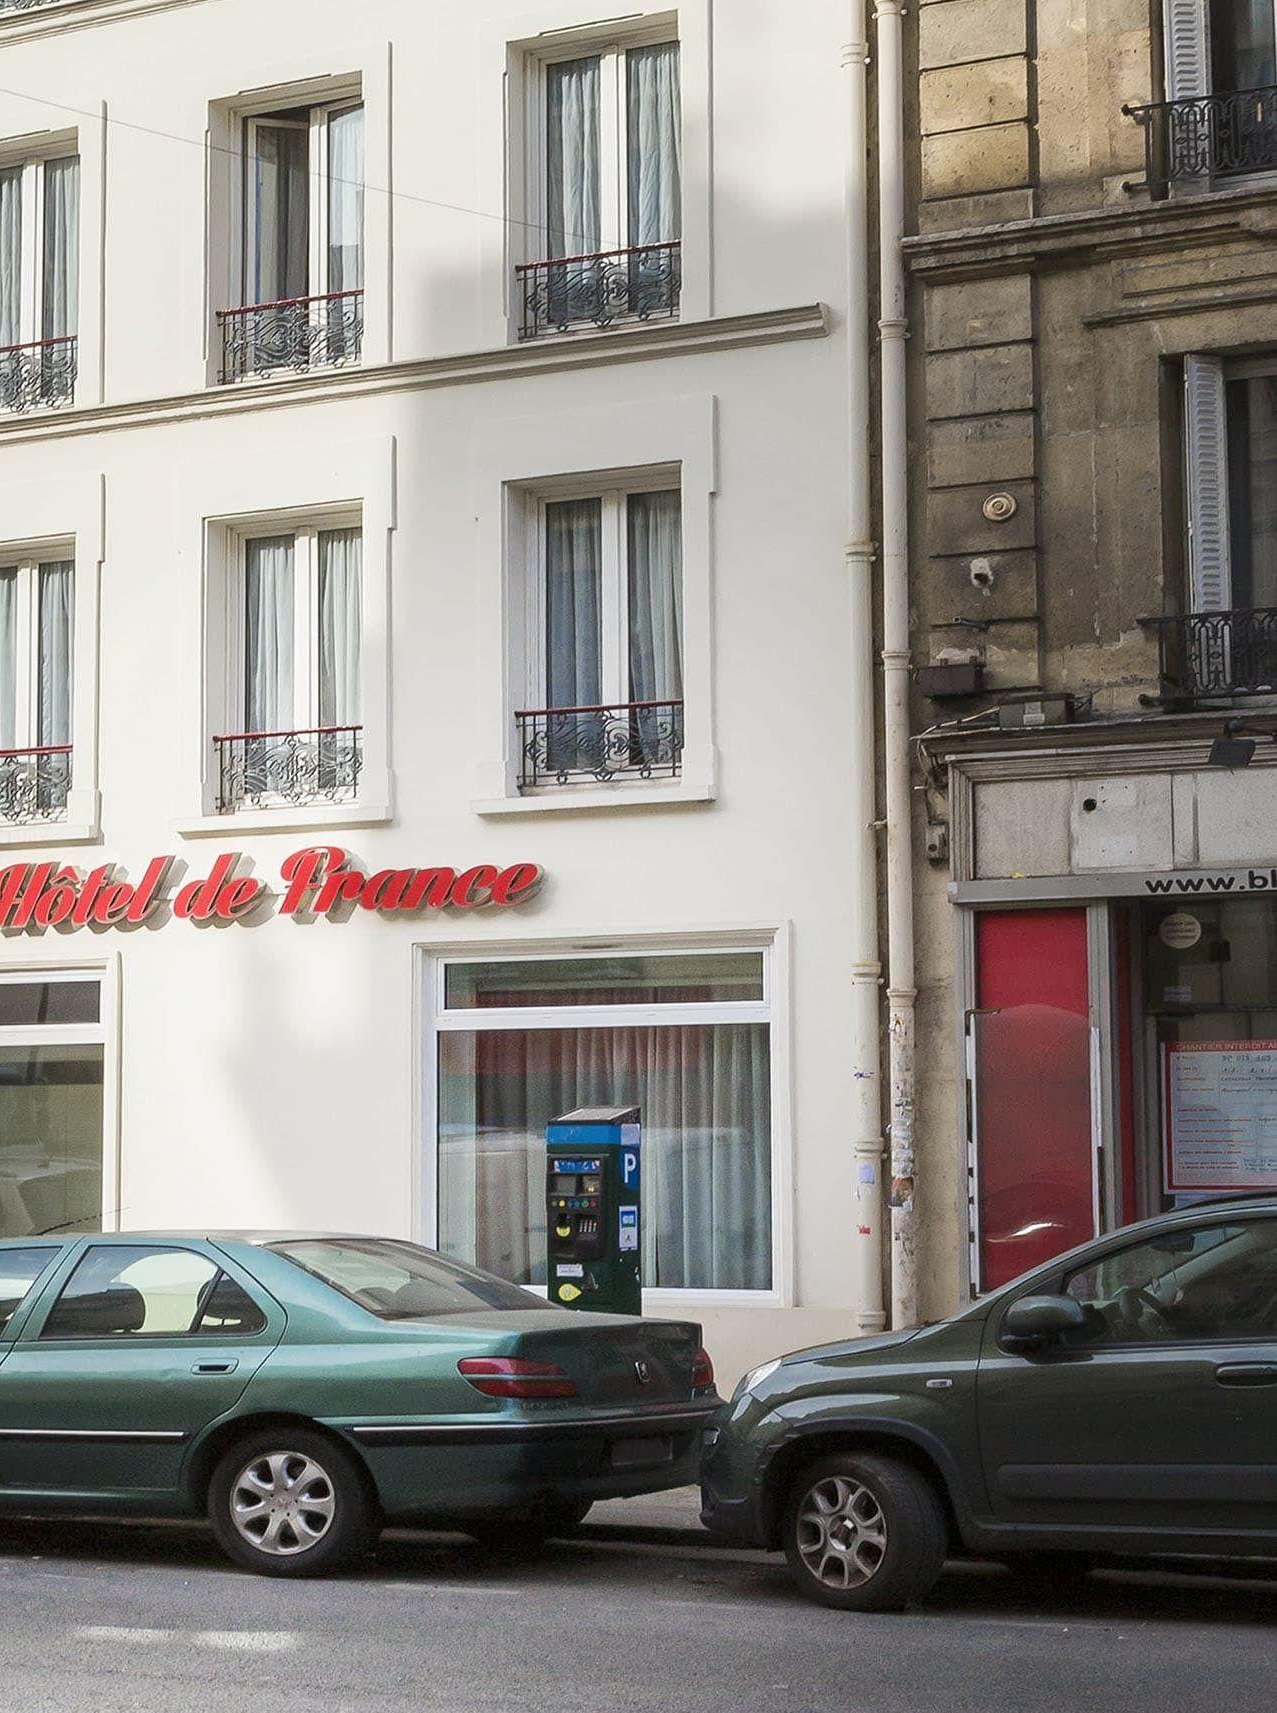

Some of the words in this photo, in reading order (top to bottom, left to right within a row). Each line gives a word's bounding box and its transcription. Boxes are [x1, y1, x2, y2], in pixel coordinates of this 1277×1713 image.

[173, 852, 263, 920] de
[278, 845, 542, 915] France
[624, 1153, 637, 1184] P
